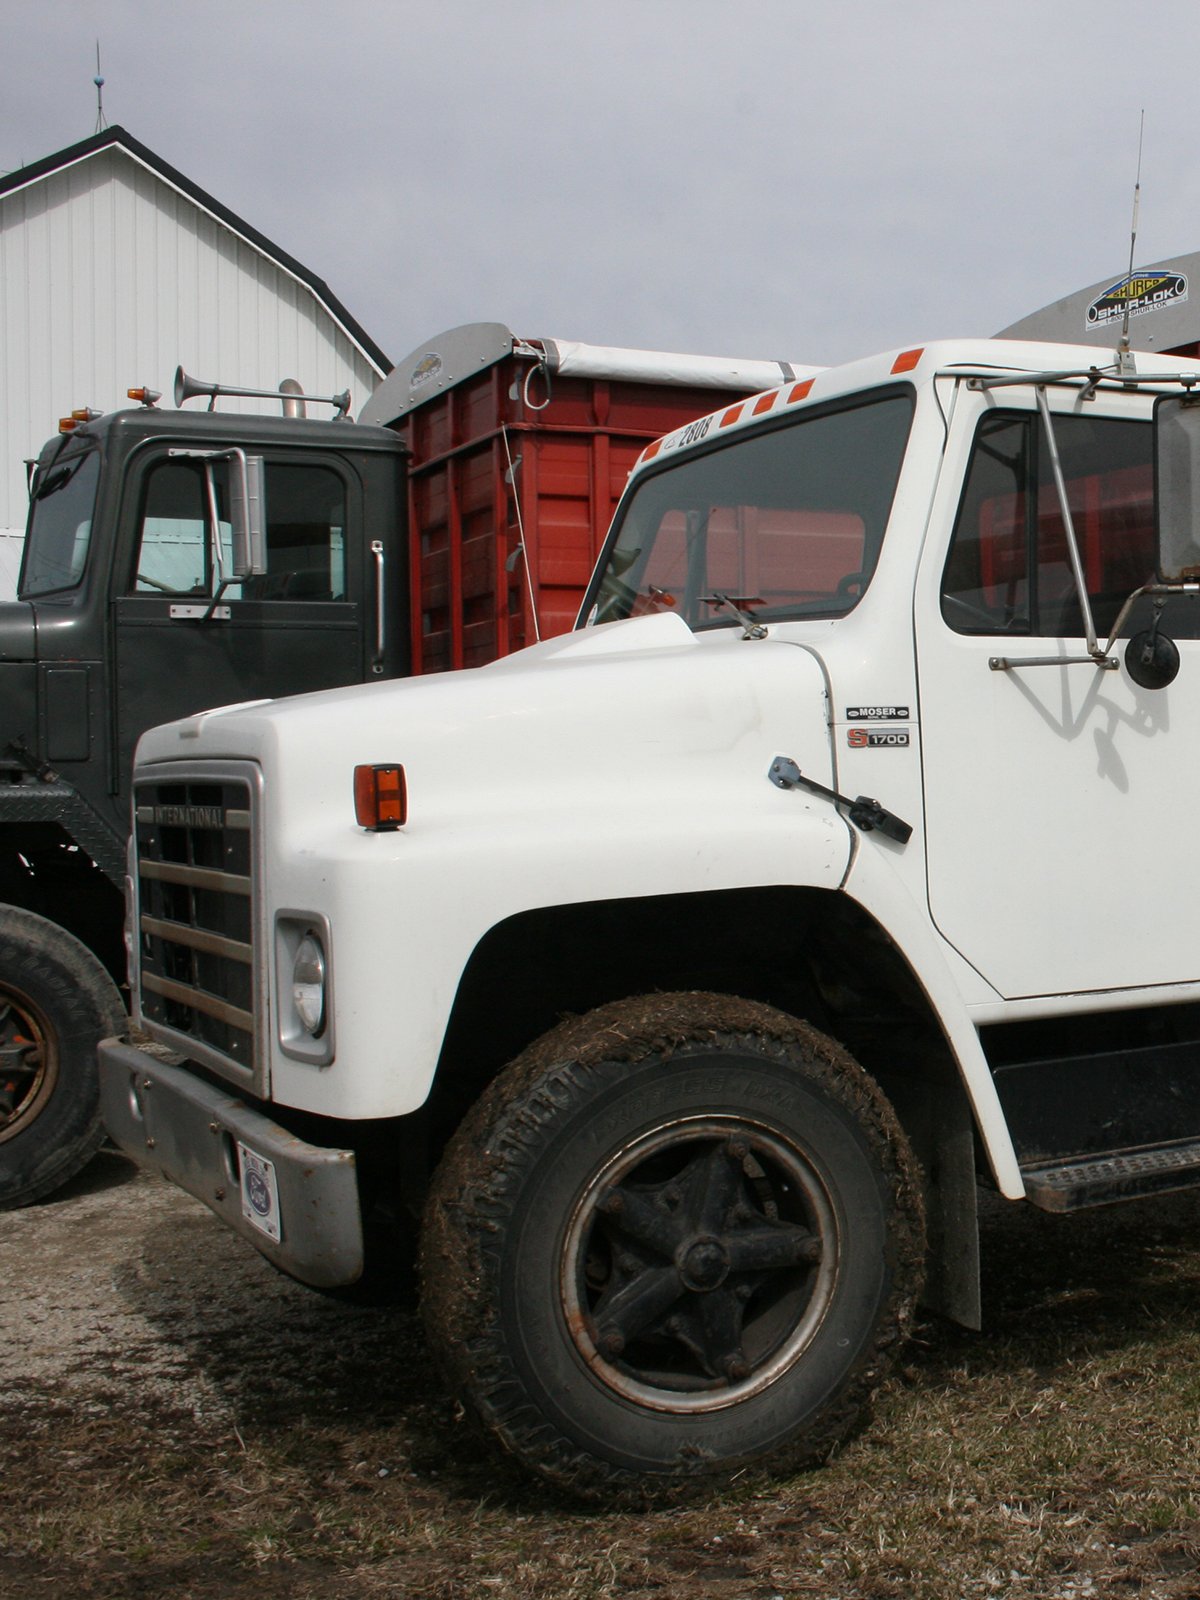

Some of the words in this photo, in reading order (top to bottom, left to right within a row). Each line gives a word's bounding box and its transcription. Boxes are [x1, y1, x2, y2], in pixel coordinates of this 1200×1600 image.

[859, 707, 897, 716] MOSER
[871, 735, 908, 744] 1700
[155, 806, 224, 829] INTERNATIONAL
